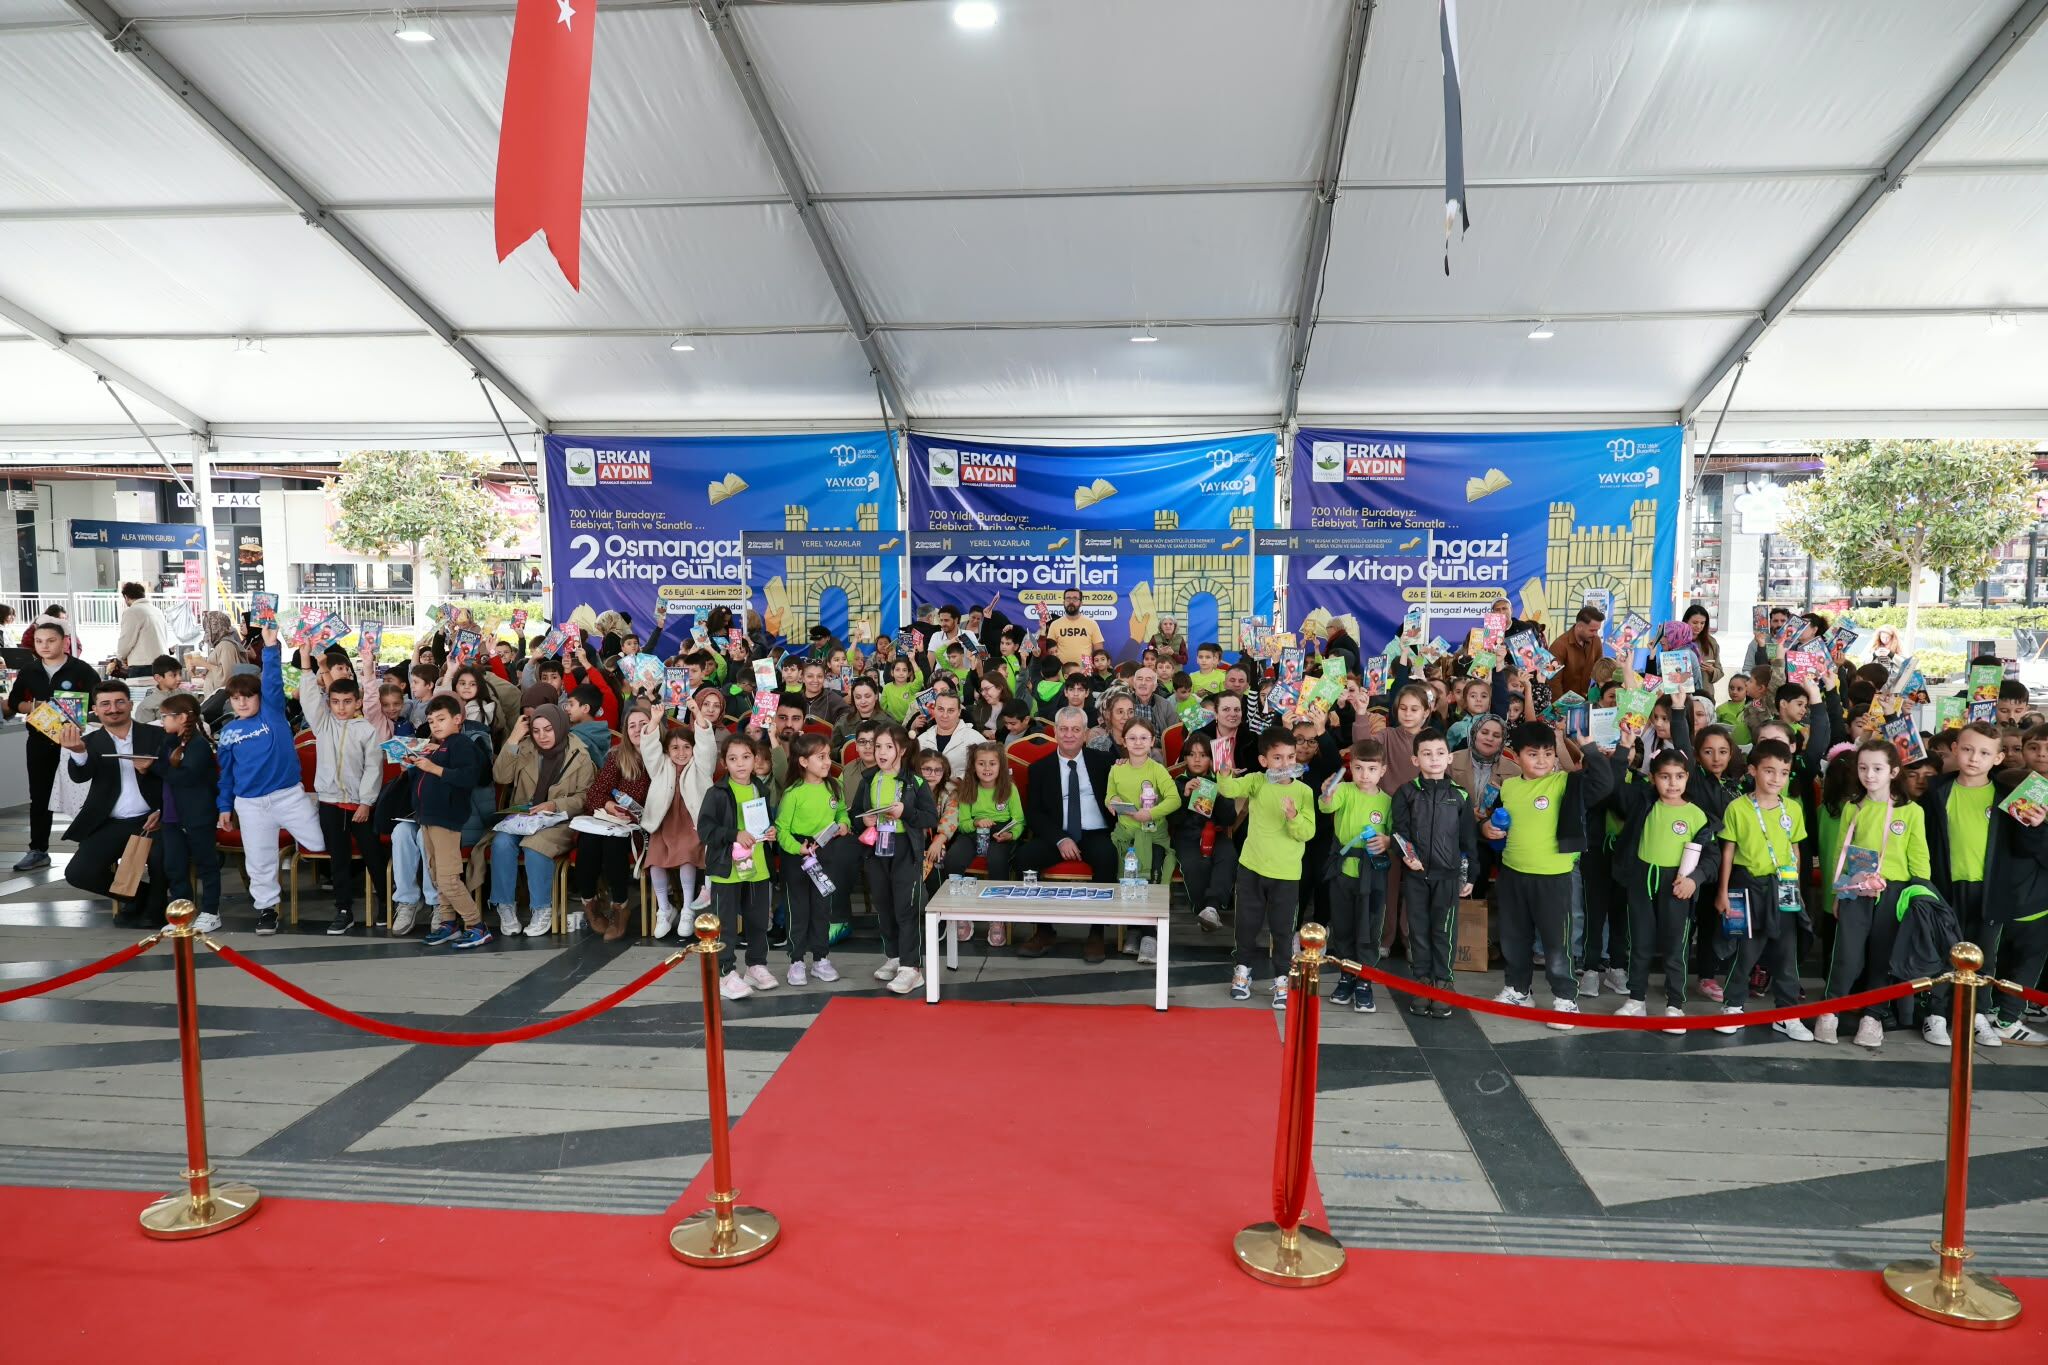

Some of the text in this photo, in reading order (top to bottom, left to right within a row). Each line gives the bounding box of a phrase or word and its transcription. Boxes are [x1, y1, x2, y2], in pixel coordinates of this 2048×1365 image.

[596, 450, 650, 464] ERKAN
[1346, 444, 1406, 458] ERKAN
[960, 451, 1016, 467] ERKAN
[600, 465, 650, 479] AYDIN
[1350, 460, 1401, 474] AYDIN
[963, 467, 1014, 482] AYDIN
[179, 494, 260, 505] MFAK
[569, 509, 666, 521] 700 Yıldır Buradayız:
[929, 510, 948, 520] 700
[1311, 506, 1417, 519] 700 Yıldır Buradayız:
[570, 519, 614, 531] Edebiyat,
[616, 519, 640, 530] Tarih
[641, 522, 653, 530] ve
[655, 519, 693, 530] Sanatla
[1311, 518, 1358, 529] Edebiyat,
[1361, 518, 1387, 528] Tarih
[1404, 519, 1445, 529] Sanatla
[121, 533, 136, 541] ALFA
[137, 534, 154, 542] YAYIN
[1432, 532, 1509, 564] ngazi
[570, 534, 606, 579] 2.
[606, 559, 752, 584] Kitap Günleri
[965, 562, 1118, 588] Kitap Günleri
[1348, 559, 1413, 587] Kitap
[1418, 559, 1509, 580] Günleri
[674, 588, 695, 598] Eylül
[1092, 593, 1113, 601] 2026
[1463, 606, 1494, 615] Meyda
[1059, 627, 1088, 637] USPA
